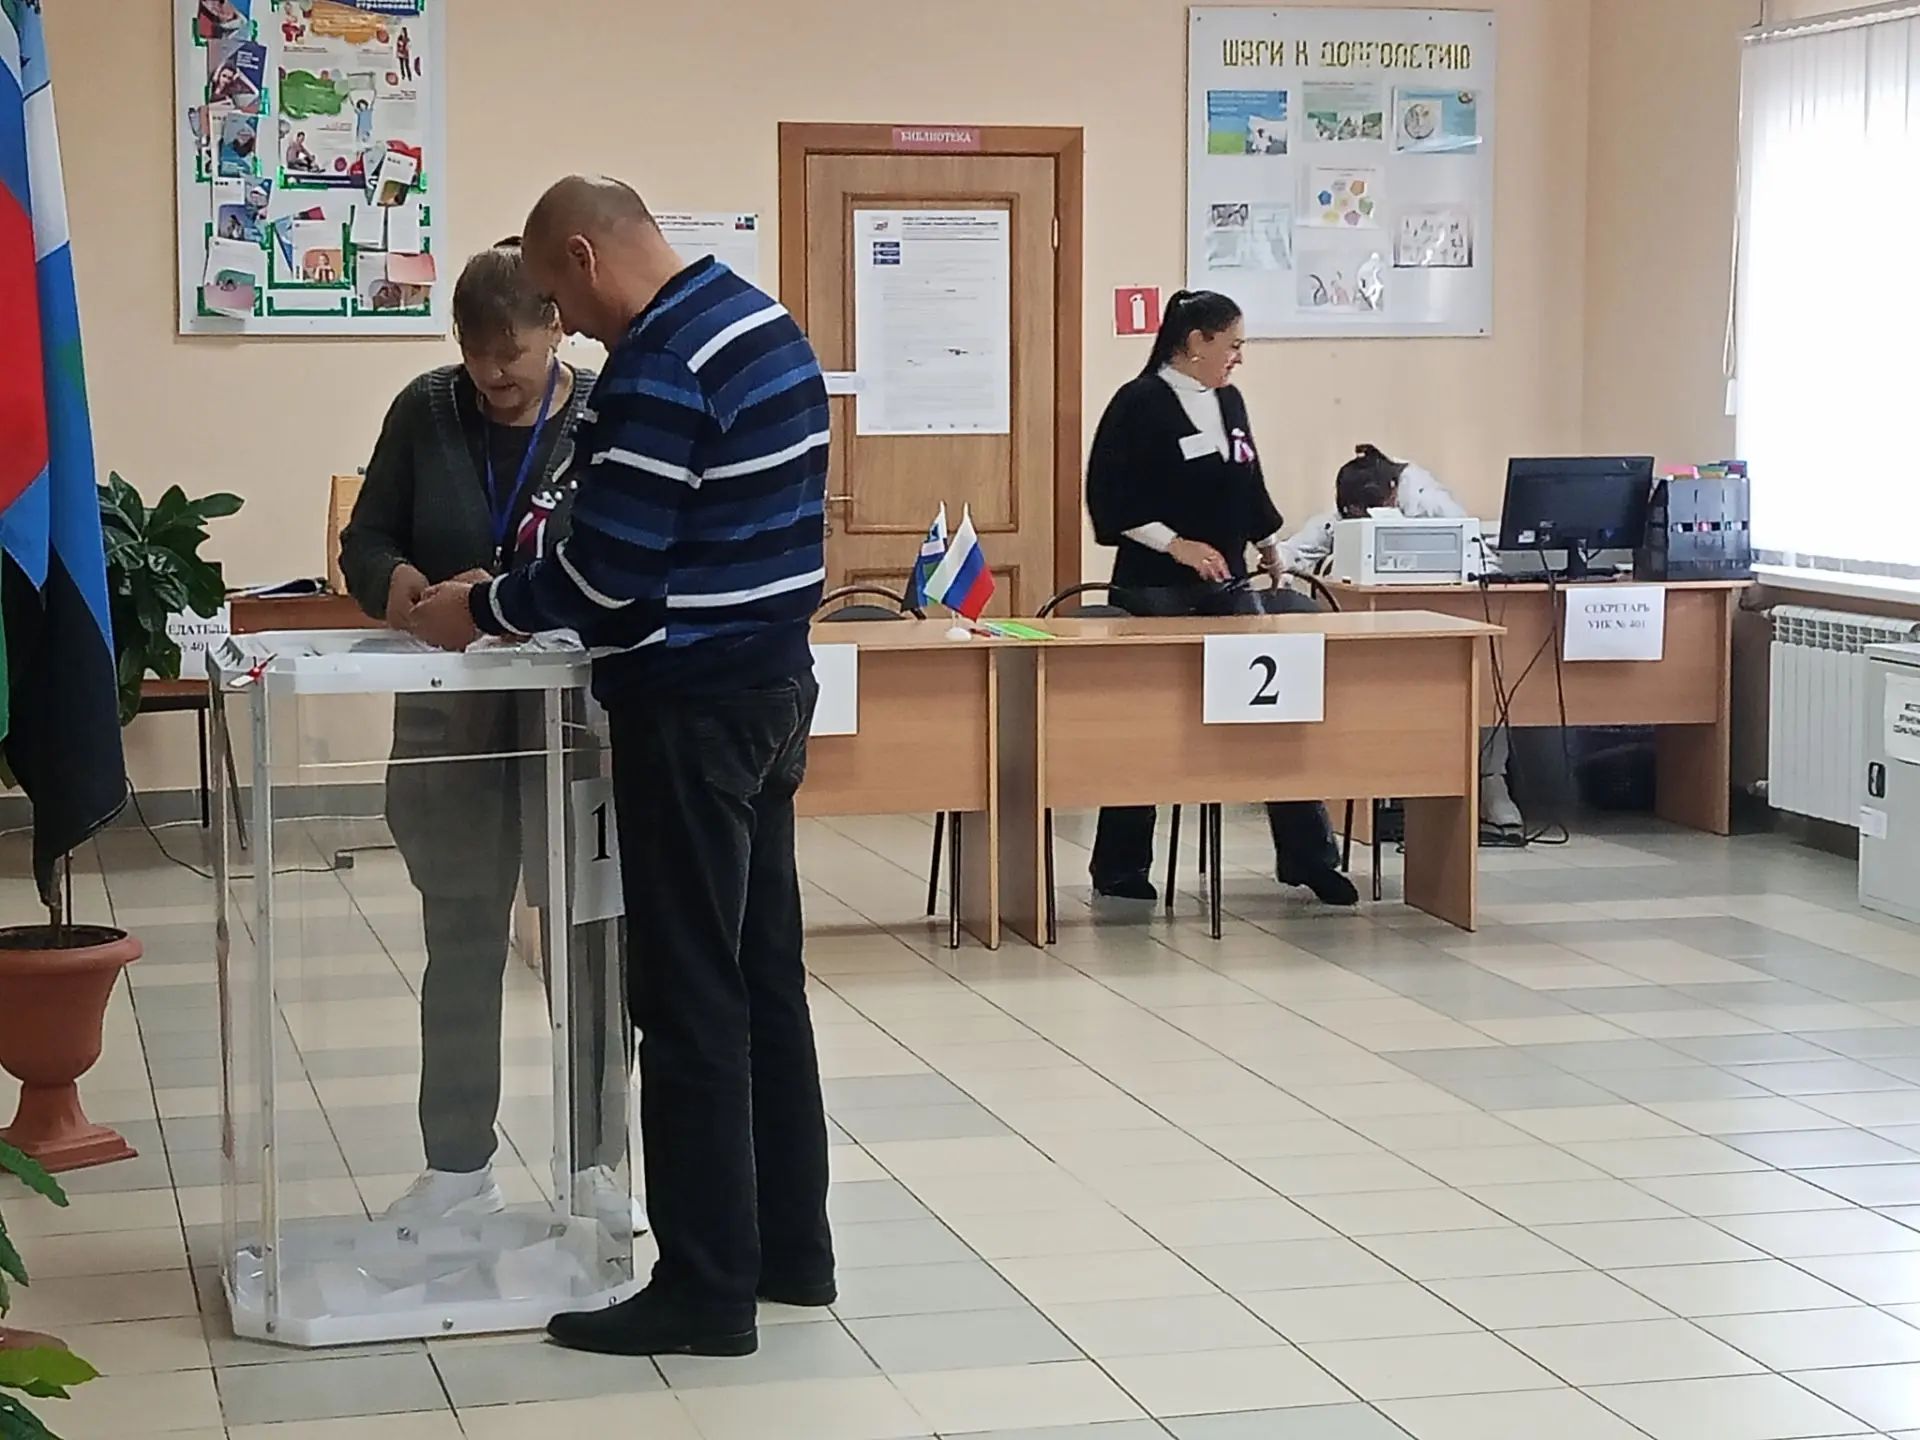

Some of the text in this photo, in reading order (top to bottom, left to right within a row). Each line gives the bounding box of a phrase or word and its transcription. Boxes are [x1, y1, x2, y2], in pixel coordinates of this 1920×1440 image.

[1223, 39, 1471, 69] ШАГИ К ДОЛГОЛЕТИЮ
[1584, 603, 1650, 614] СЕКРЕТАРЬ
[1587, 620, 1612, 630] УИК
[1248, 654, 1280, 706] 2
[591, 802, 611, 862] 1
